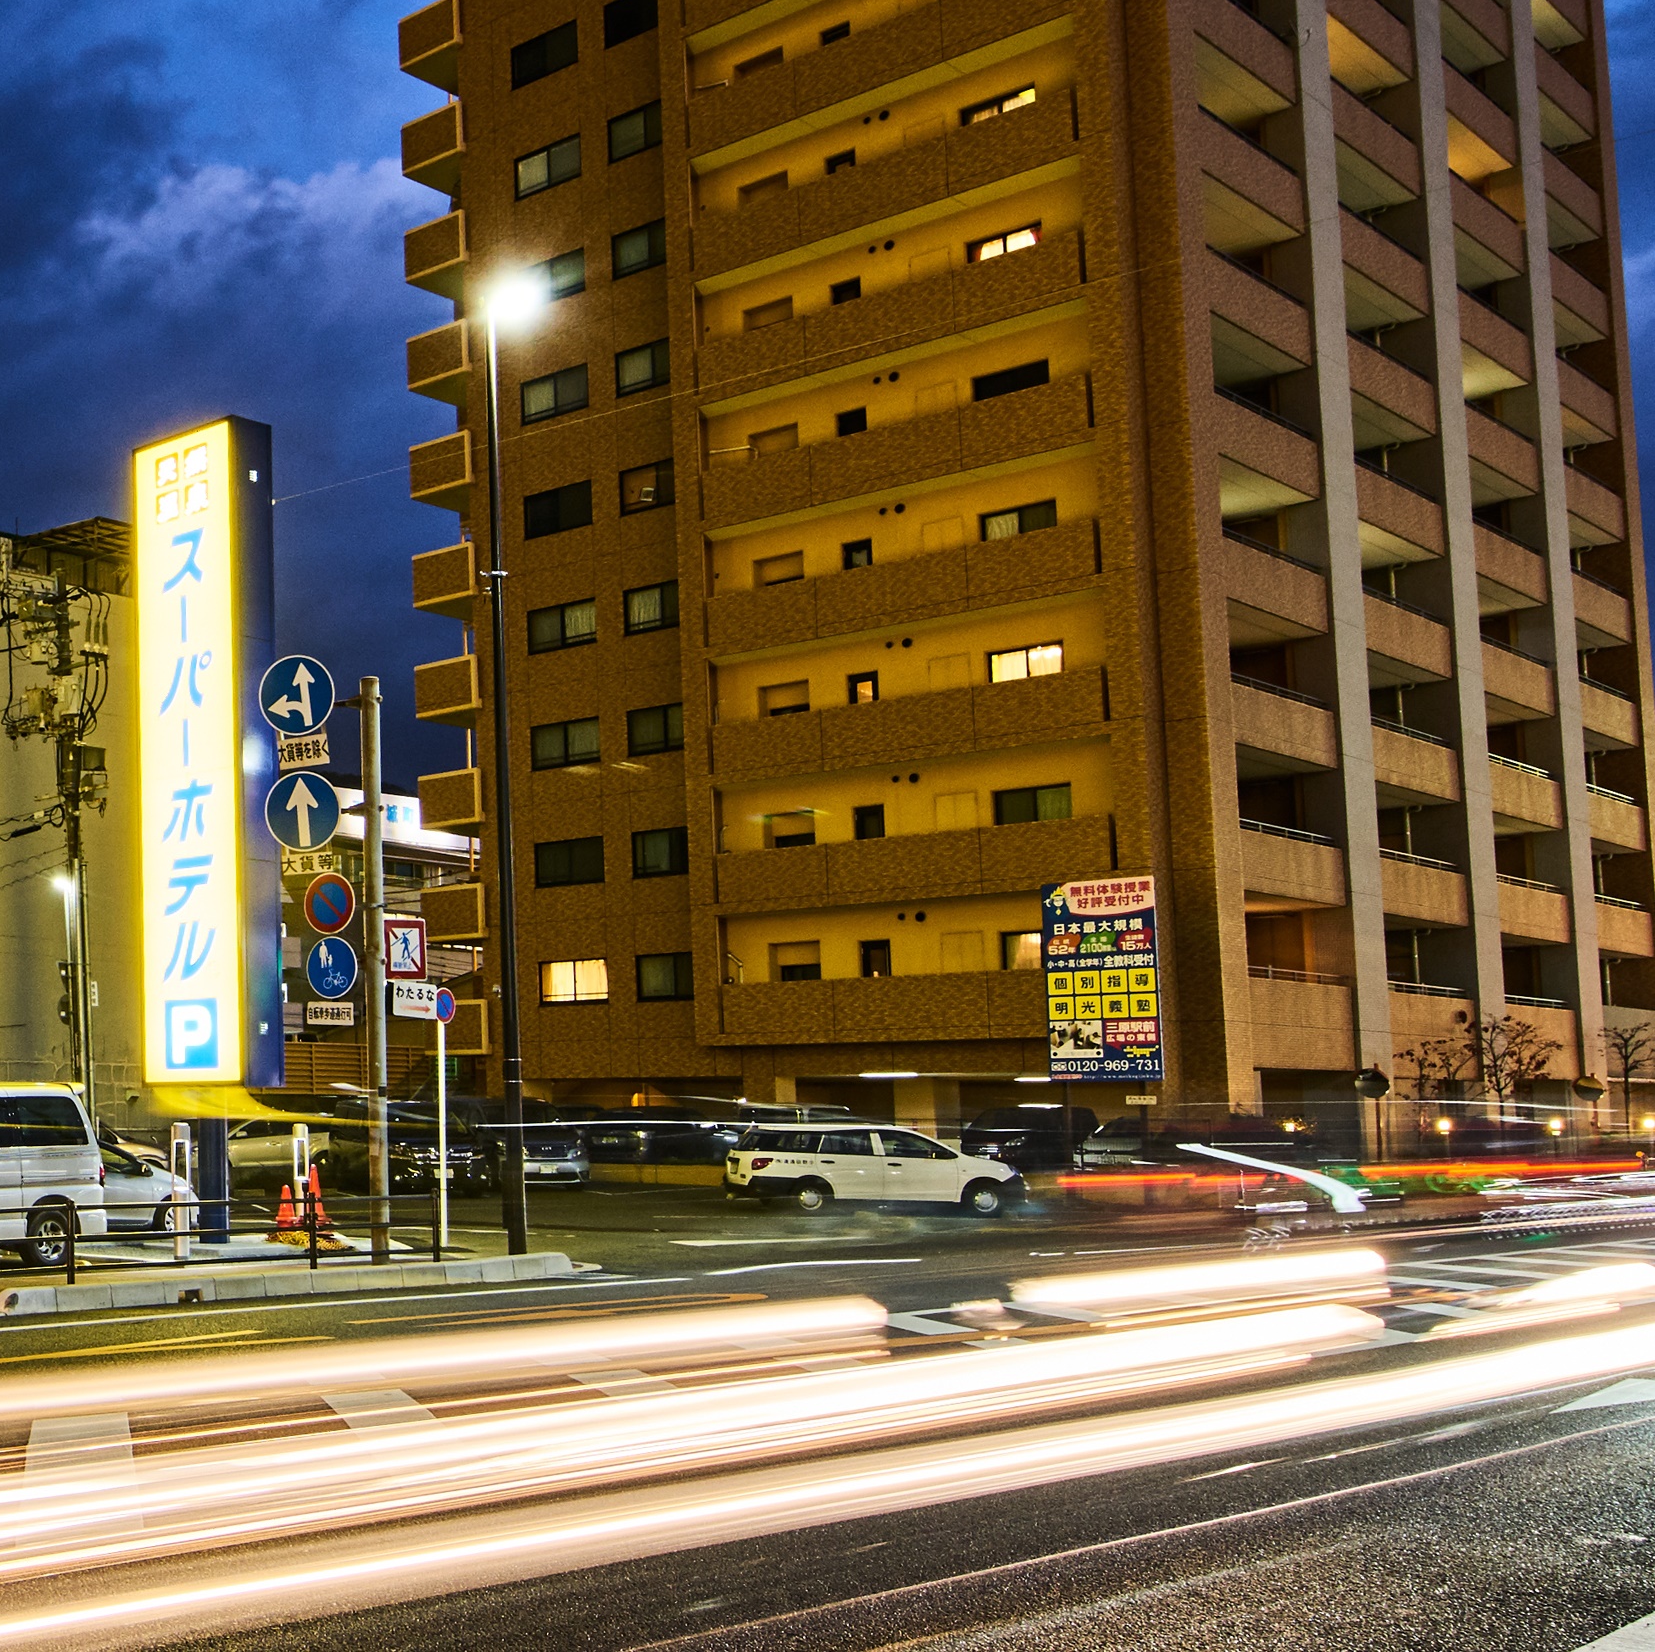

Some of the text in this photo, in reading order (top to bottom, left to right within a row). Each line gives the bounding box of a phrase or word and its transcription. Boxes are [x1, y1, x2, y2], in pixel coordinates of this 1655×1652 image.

[159, 527, 217, 985] スーパーホテル
[278, 739, 330, 764] 大貨等を除く
[282, 854, 334, 873] 大貨等
[1070, 881, 1151, 897] 無料体験授業
[1077, 894, 1144, 909] 好評受付中
[1053, 918, 1143, 935] 日本最大規模
[1121, 940, 1152, 951] 15万人
[1054, 973, 1150, 990] 個別指導
[396, 985, 435, 1001] わたるな
[1055, 999, 1151, 1015] 明光義塾
[171, 1004, 213, 1065] P
[1106, 1021, 1156, 1033] 三原駅前
[1068, 1059, 1160, 1072] 0120-969-731
